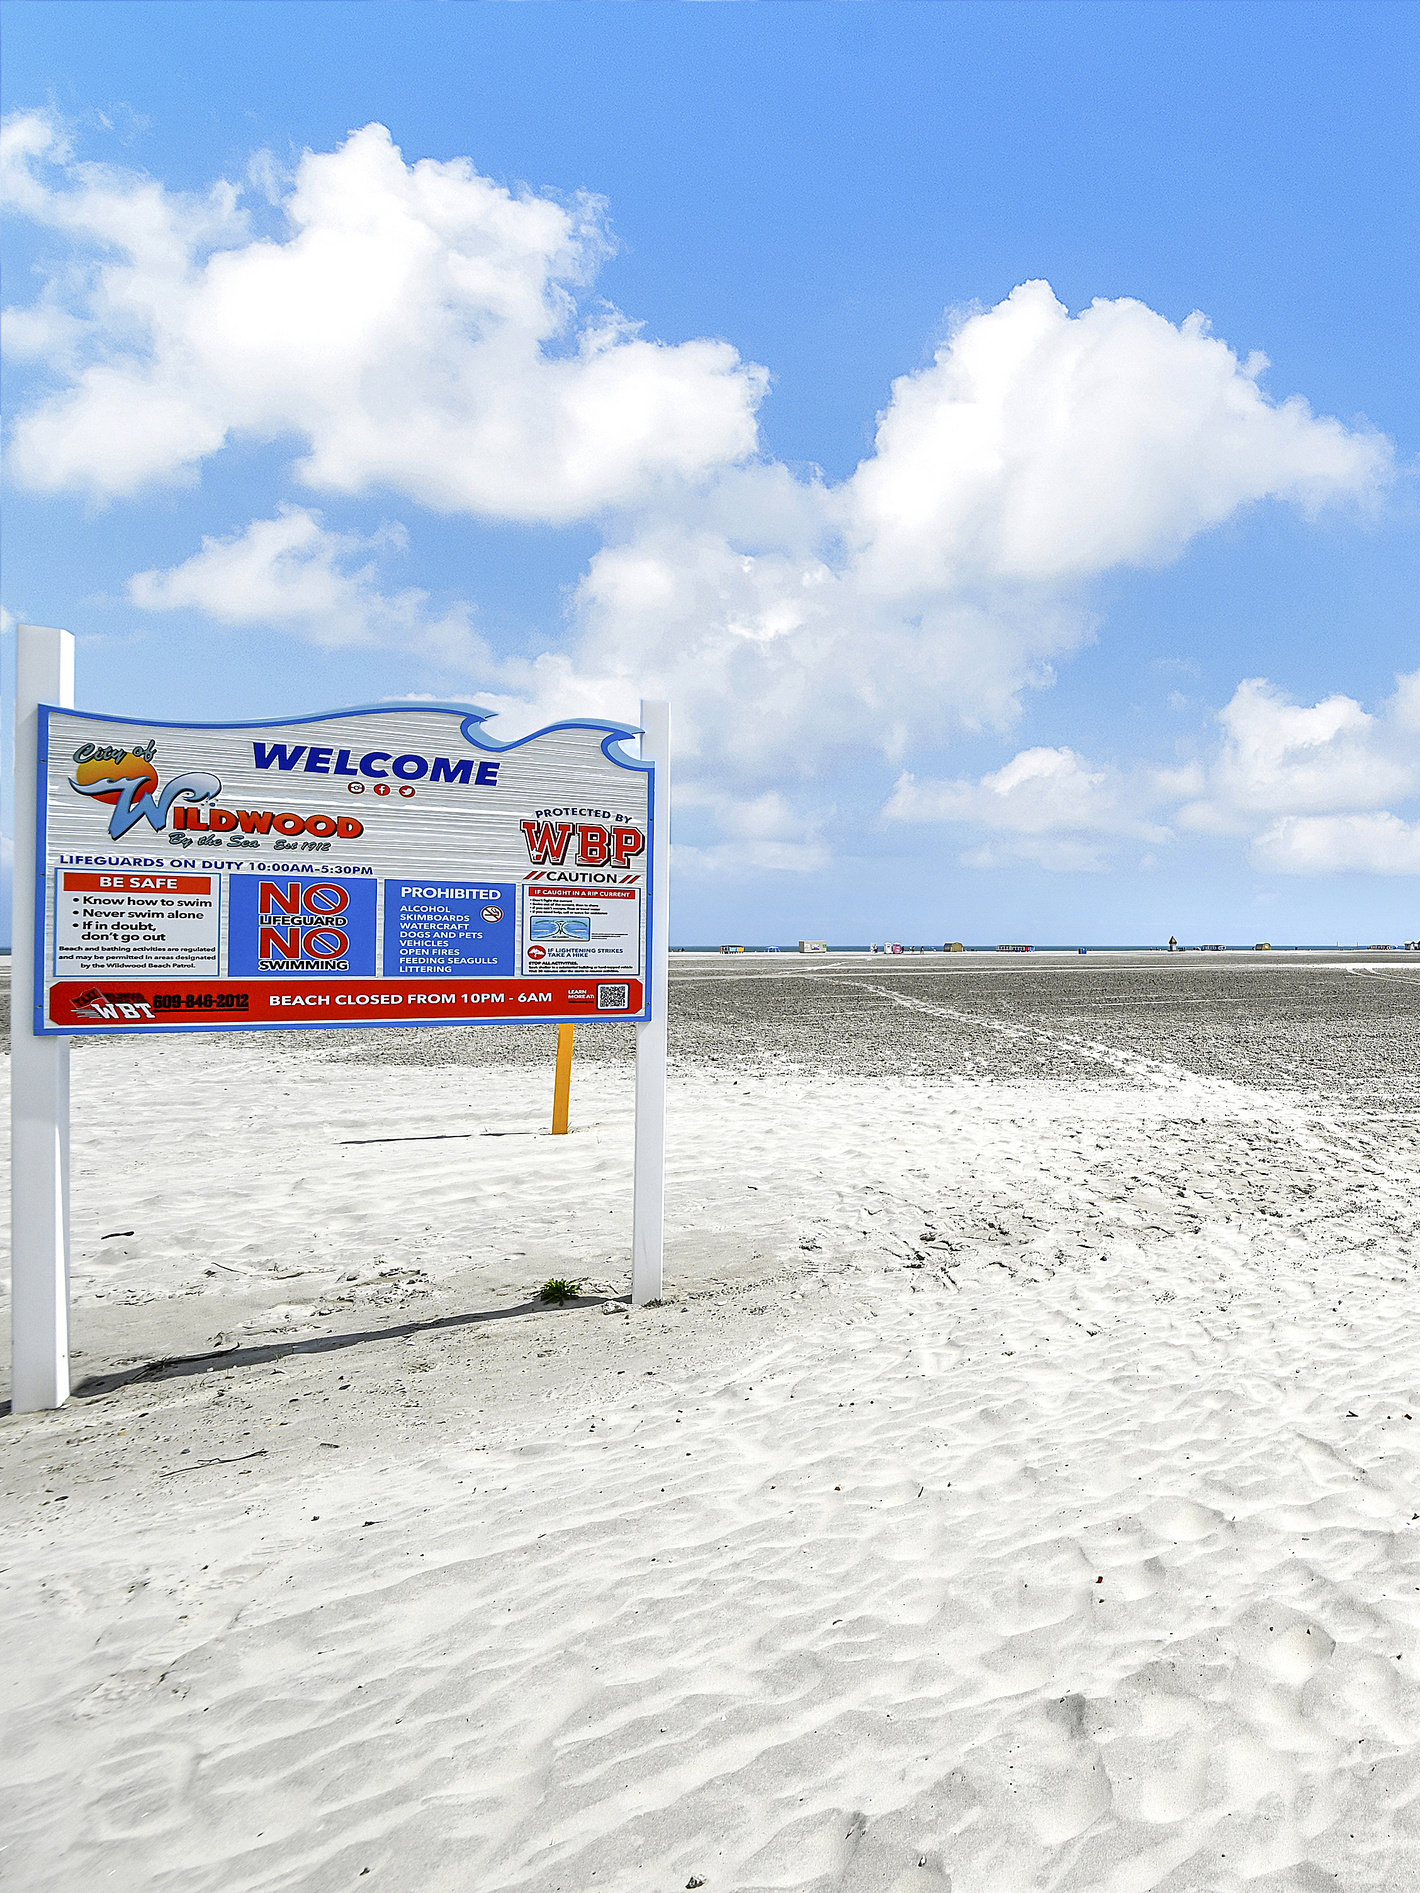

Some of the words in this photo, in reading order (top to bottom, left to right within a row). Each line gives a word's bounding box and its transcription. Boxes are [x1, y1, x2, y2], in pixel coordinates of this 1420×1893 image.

[73, 743, 128, 765] City
[132, 739, 157, 763] of
[252, 742, 501, 787] WELCOME
[68, 772, 364, 841] WILDWOOD
[535, 807, 611, 819] PROTECTED
[615, 813, 632, 824] BY
[168, 832, 193, 848] By
[197, 834, 222, 847] the
[227, 836, 260, 849] Sea
[273, 839, 297, 850] Est
[300, 841, 332, 851] 1912
[520, 819, 645, 869] WBP
[60, 855, 164, 868] LIFEGUARDS
[170, 859, 196, 869] ON
[202, 861, 244, 870] DUTY
[249, 862, 373, 875] 10:00AM-5:30PM
[100, 877, 124, 888] BE
[130, 877, 178, 889] SAFE
[546, 871, 618, 884] CAUTION
[259, 881, 350, 916] NO
[401, 887, 502, 900] PROHIBITED
[83, 896, 124, 906] Know
[128, 897, 157, 907] how
[161, 898, 175, 907] to
[177, 899, 213, 908] swim
[83, 909, 125, 919] Never
[128, 911, 164, 919] swim
[167, 911, 204, 920] alone
[259, 916, 347, 926] LIFEGUARD
[400, 914, 470, 922] SKIMBOARDS
[83, 922, 92, 931] If
[95, 922, 108, 931] in
[111, 922, 157, 932] doubt,
[81, 932, 118, 941] don't
[121, 935, 140, 943] go
[259, 926, 350, 960] NO
[259, 960, 349, 970] SWIMMING
[269, 995, 330, 1006] BEACH
[335, 994, 403, 1006] CLOSED
[407, 994, 456, 1004] FROM
[461, 993, 505, 1003] 10PM
[518, 992, 552, 1003] 6AM
[90, 1003, 156, 1019] WBT
[153, 994, 249, 1009] 609-846-2012
